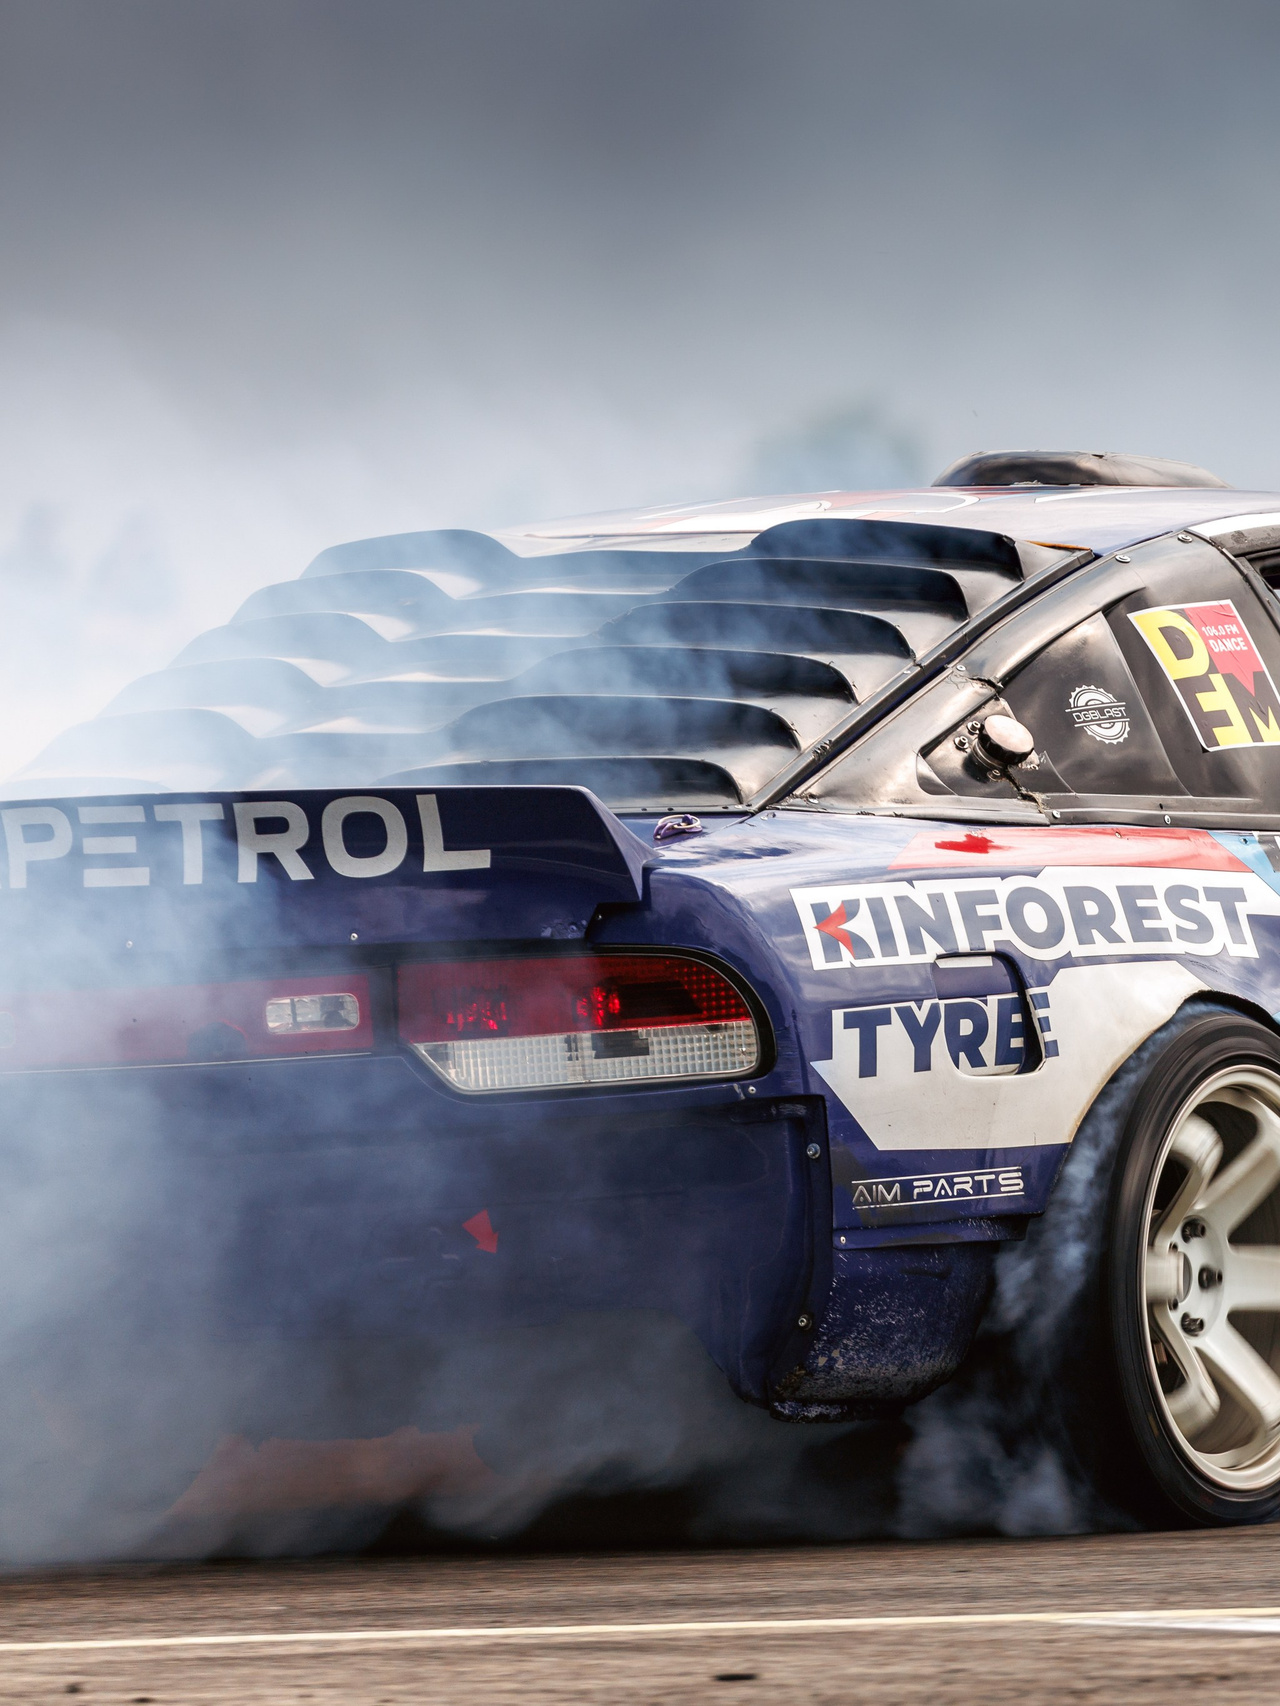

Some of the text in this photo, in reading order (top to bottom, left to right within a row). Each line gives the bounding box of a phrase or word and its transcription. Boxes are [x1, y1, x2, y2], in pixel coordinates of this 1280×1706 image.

[1201, 623, 1240, 637] 106.0 FM
[1208, 637, 1248, 652] DANCE
[1072, 707, 1127, 722] DGBLAST
[810, 885, 1252, 963] KINFOREST
[843, 992, 1060, 1078] TYRE
[852, 1172, 1024, 1203] AIM PARTS
